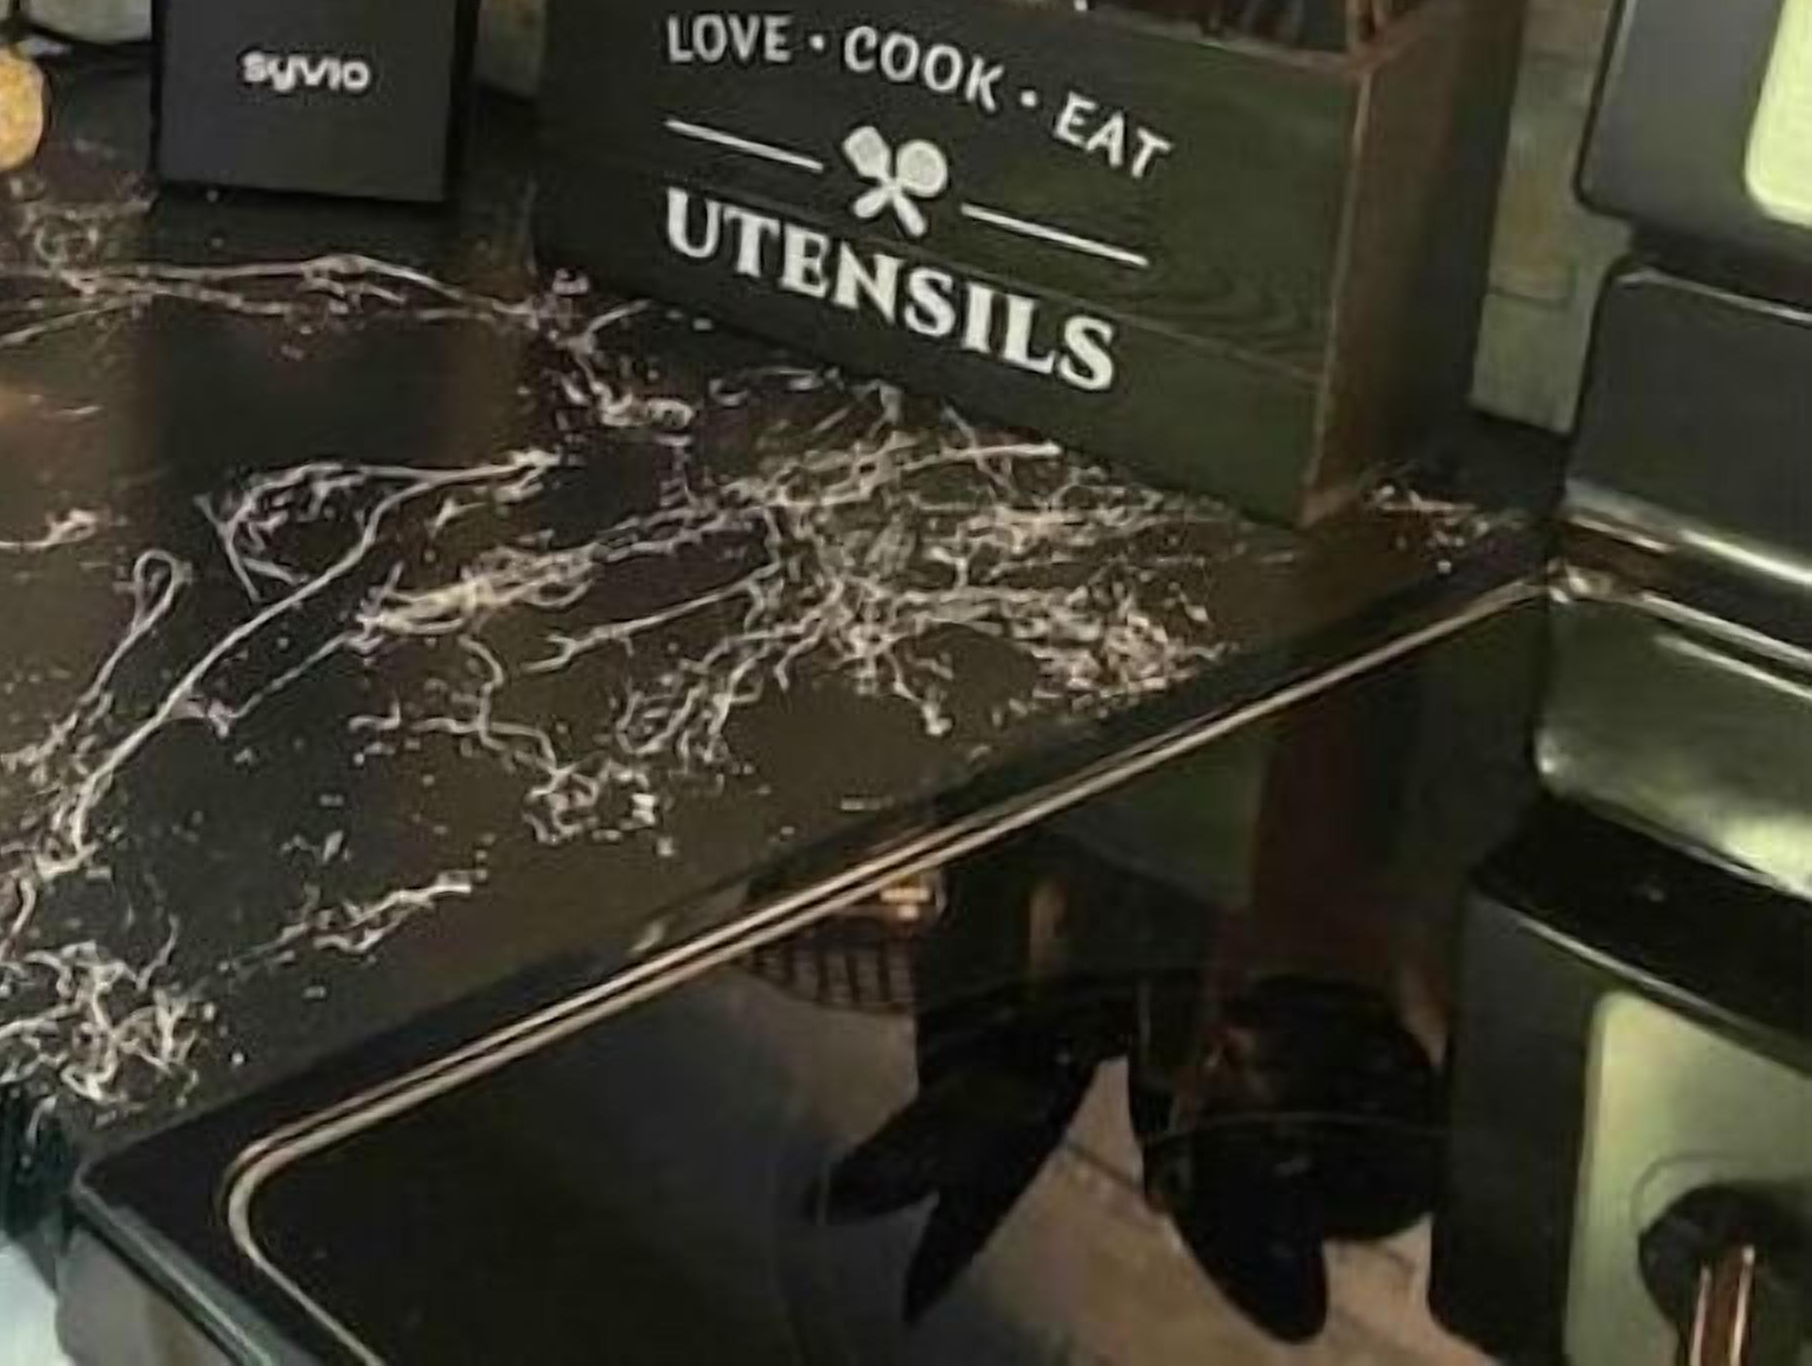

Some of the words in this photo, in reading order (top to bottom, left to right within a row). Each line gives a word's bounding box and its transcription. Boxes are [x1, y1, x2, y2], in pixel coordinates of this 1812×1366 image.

[666, 13, 791, 62] LOVE
[843, 25, 1005, 111] COOK
[1052, 91, 1173, 179] EAT
[666, 186, 1117, 390] UTENSILS
